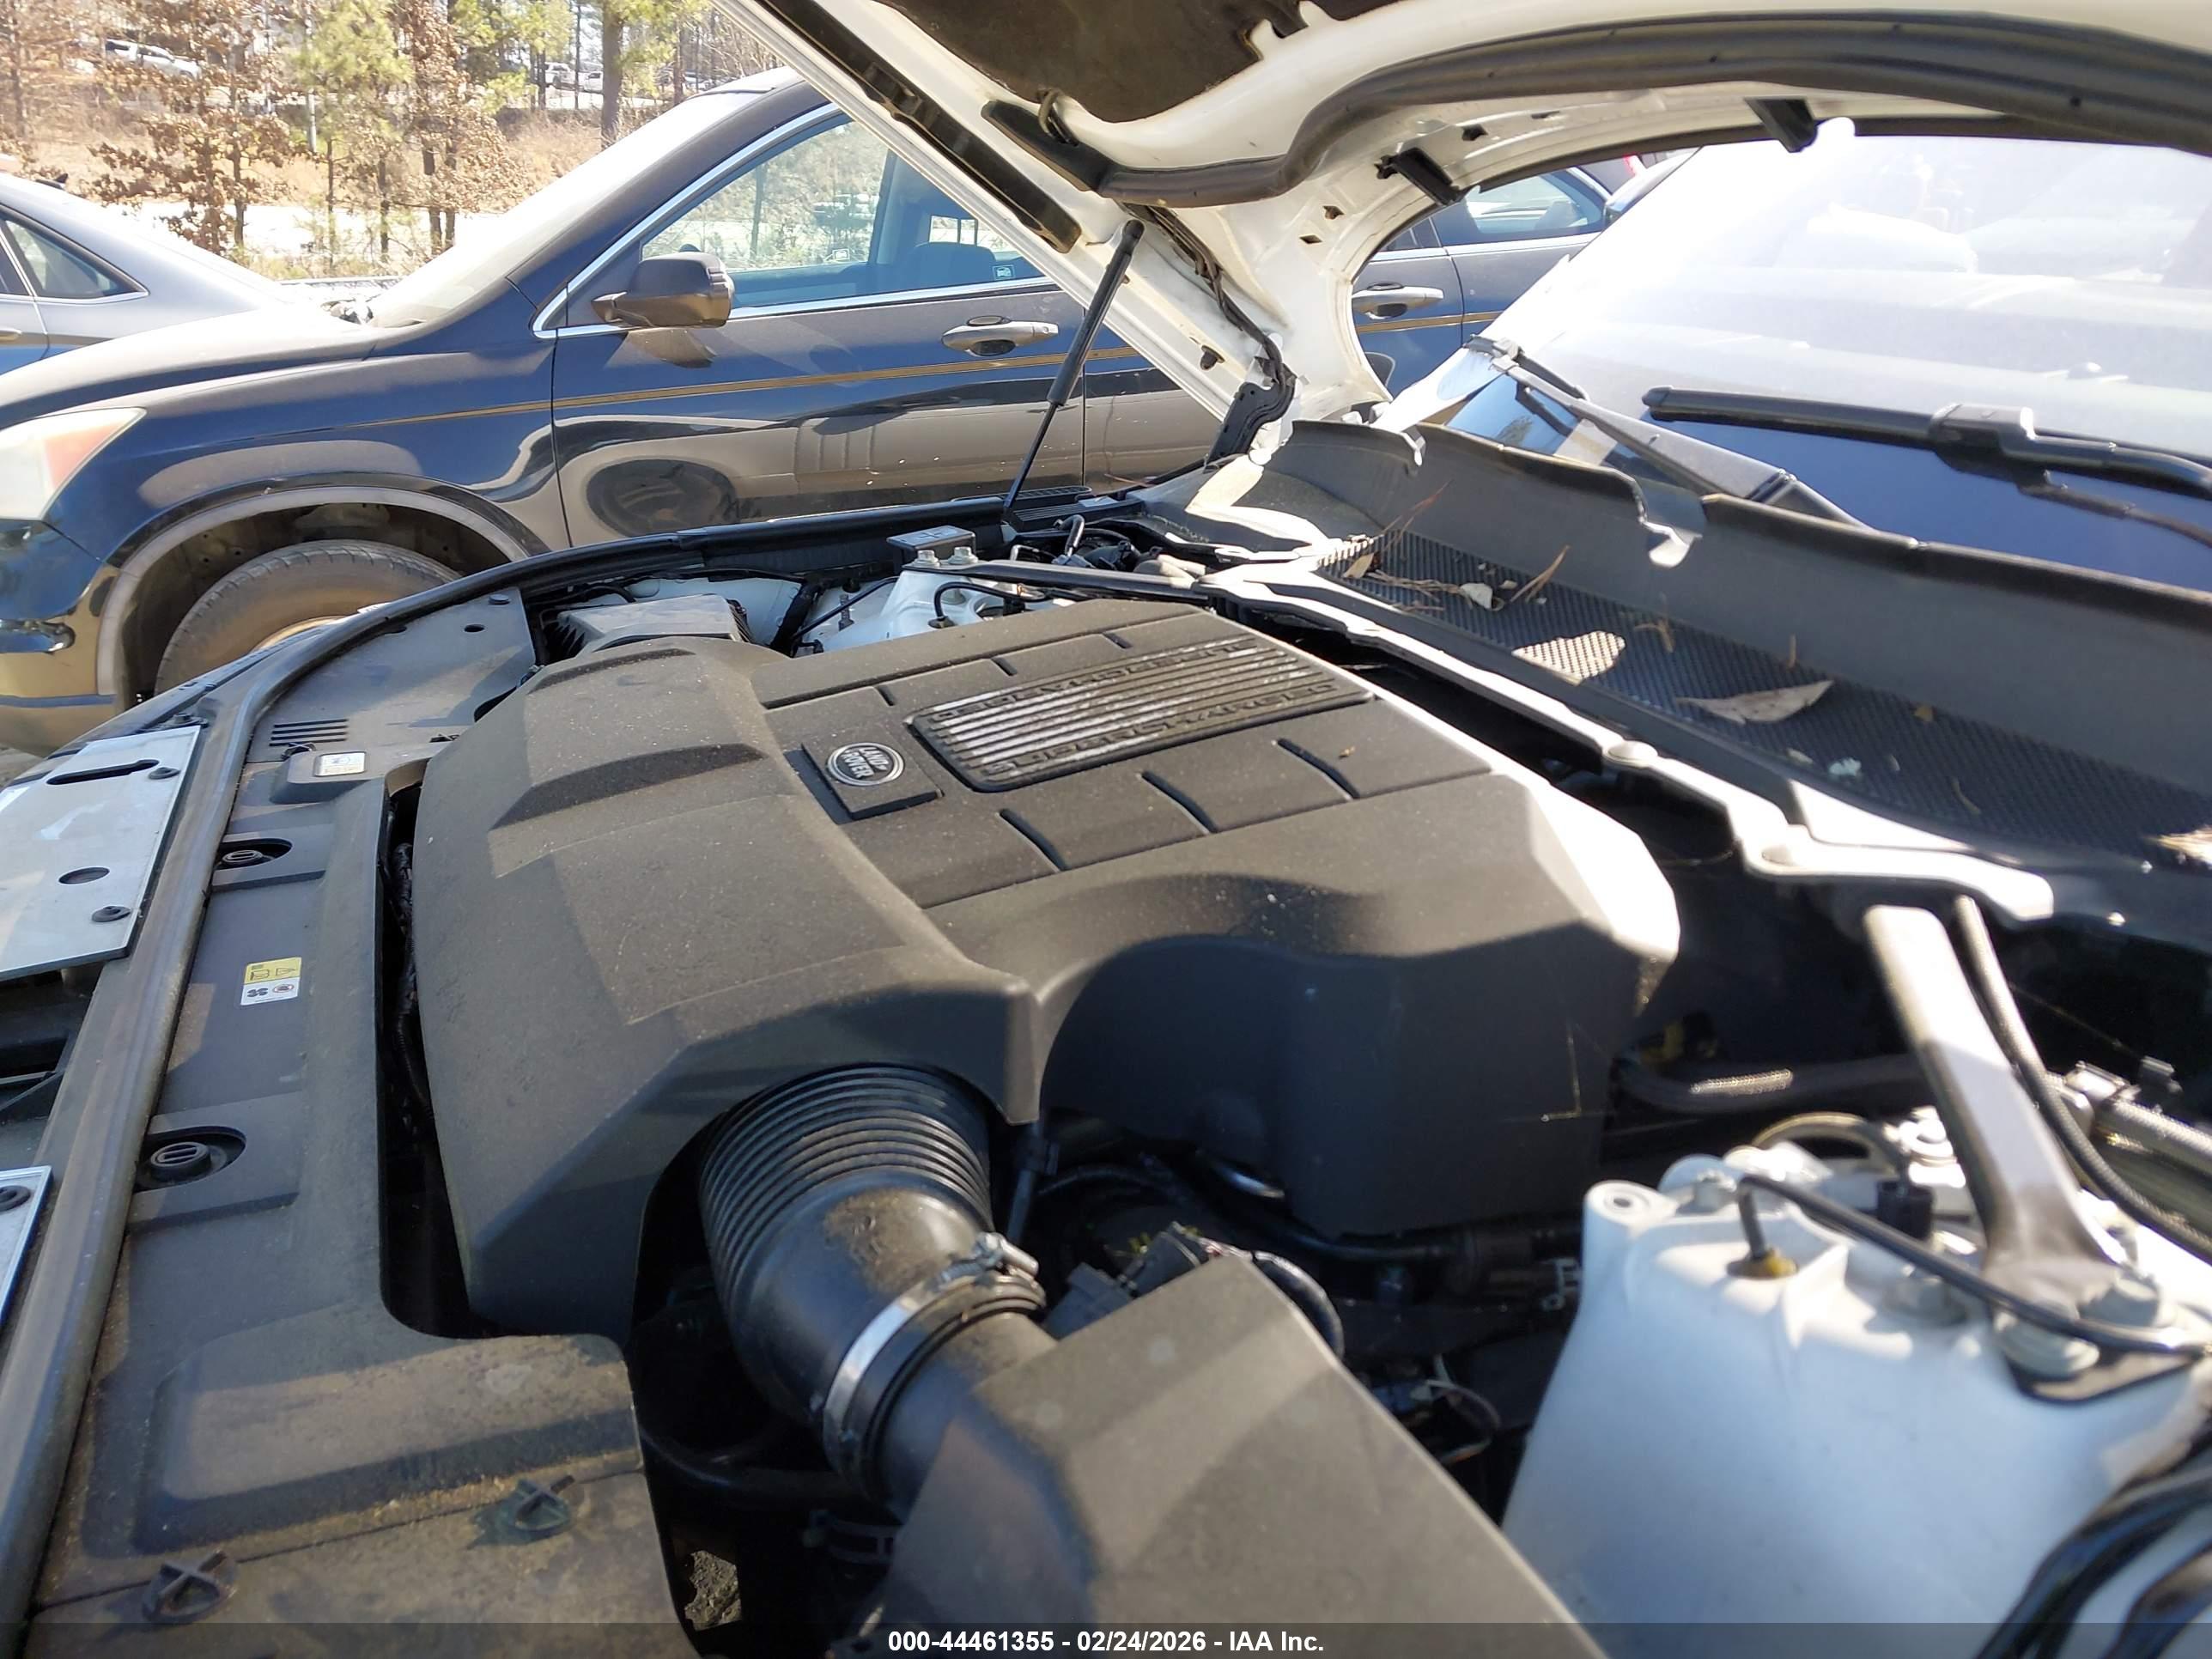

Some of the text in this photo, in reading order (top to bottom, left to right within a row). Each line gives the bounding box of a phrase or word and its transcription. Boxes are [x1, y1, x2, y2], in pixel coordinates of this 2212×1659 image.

[982, 684, 1338, 775] SUPERCHARGED
[842, 751, 874, 779] ROVER
[858, 746, 889, 768] LAND
